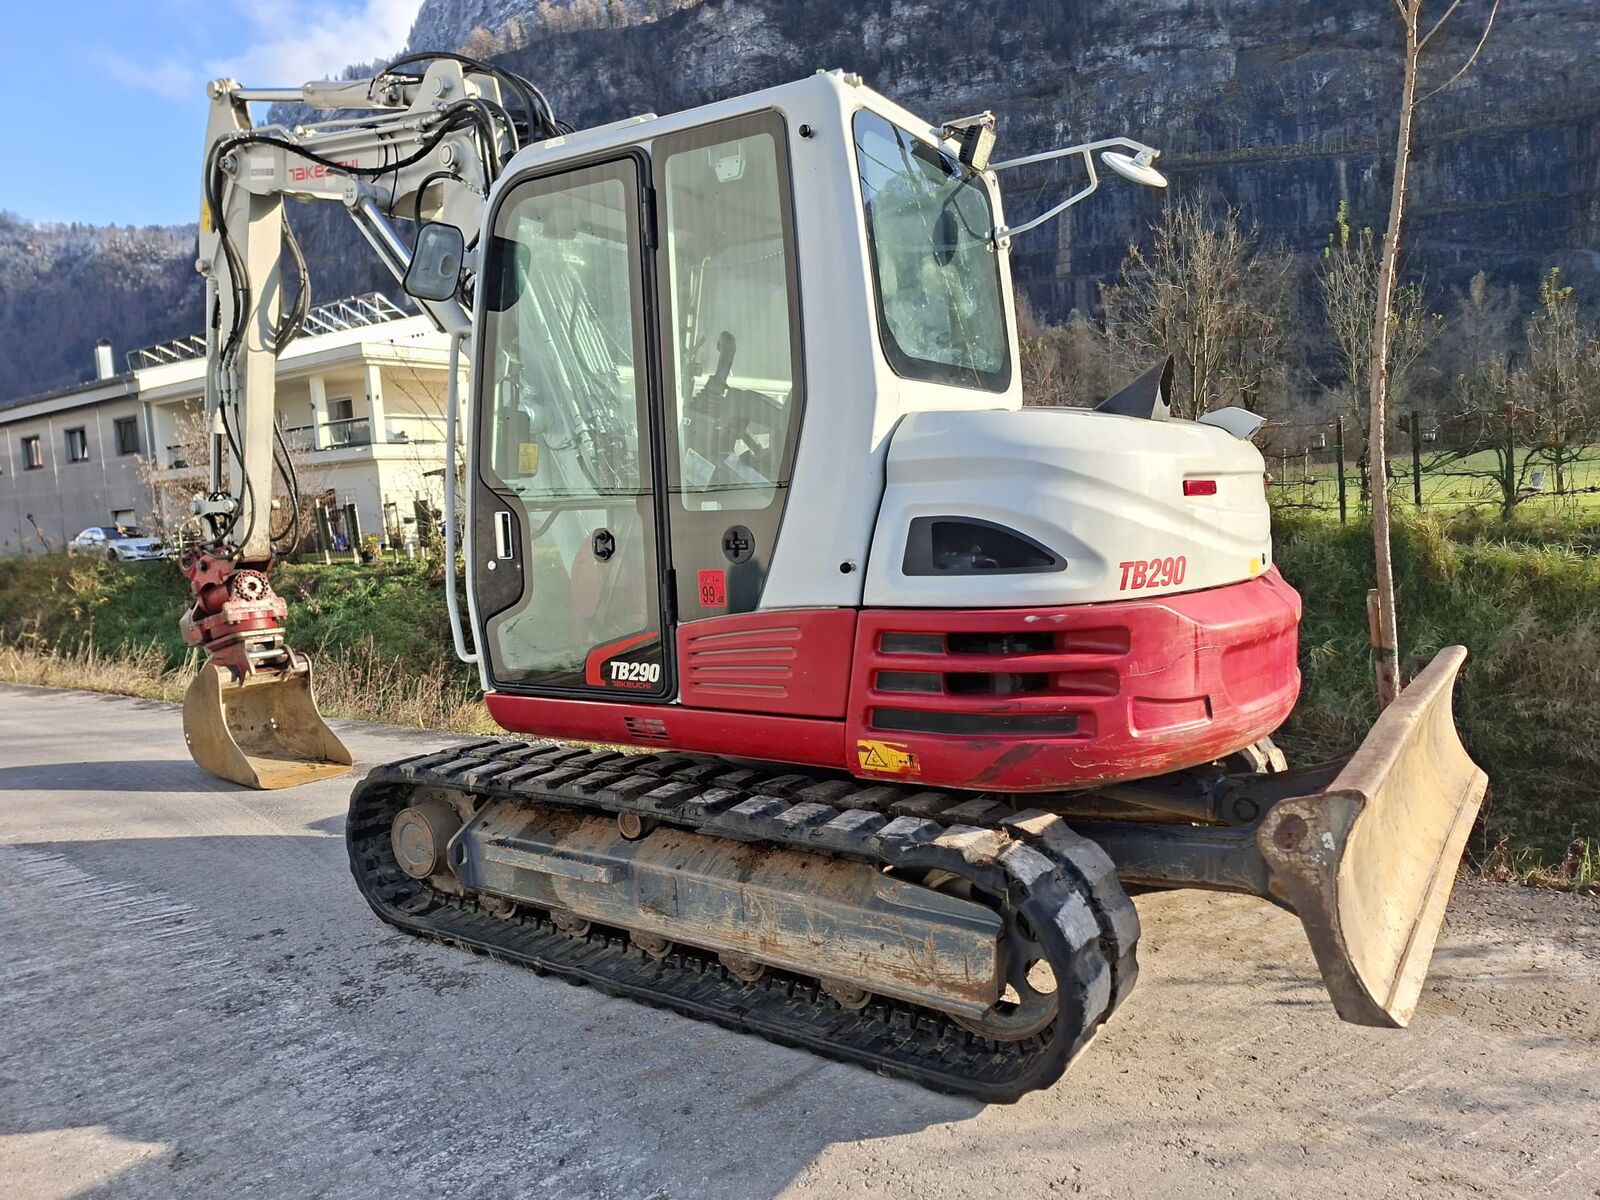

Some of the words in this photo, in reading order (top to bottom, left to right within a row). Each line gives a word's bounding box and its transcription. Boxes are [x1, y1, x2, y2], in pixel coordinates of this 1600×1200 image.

[1119, 555, 1187, 590] TB290
[702, 585, 715, 603] 99
[610, 661, 660, 683] TB290
